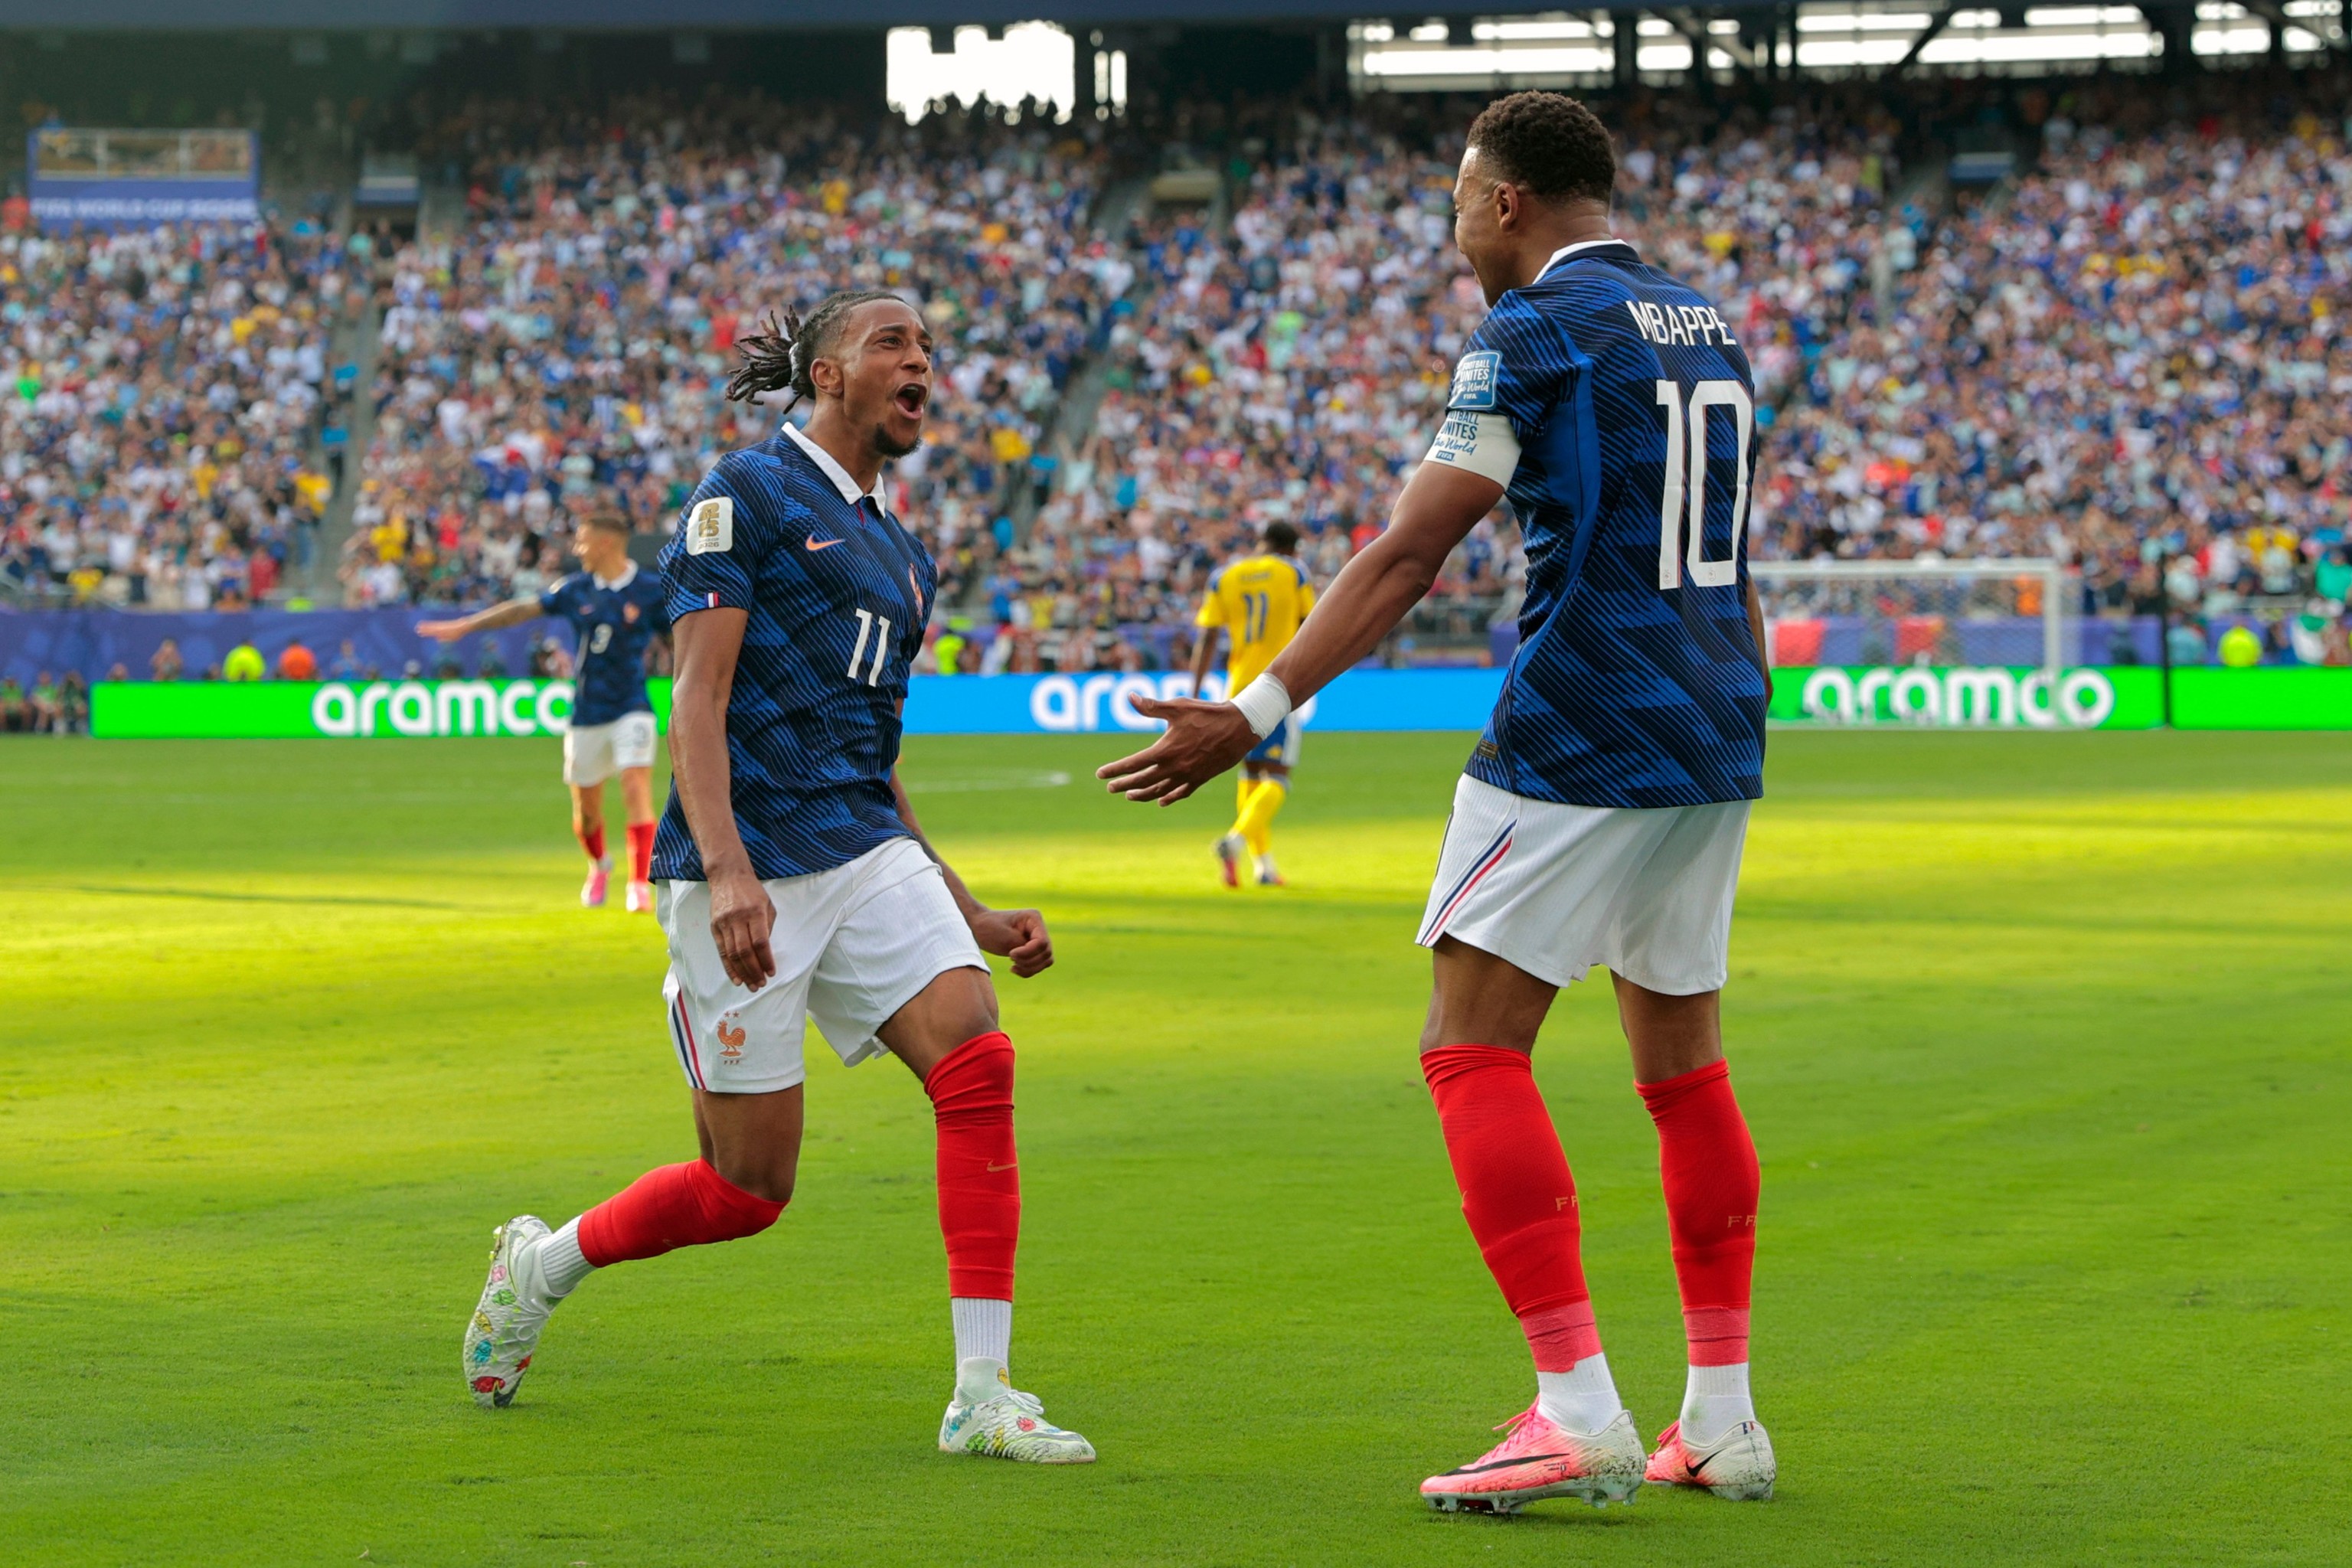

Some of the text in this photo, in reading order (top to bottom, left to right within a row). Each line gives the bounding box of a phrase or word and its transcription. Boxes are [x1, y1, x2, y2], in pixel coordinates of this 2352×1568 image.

[1625, 300, 1736, 346] MBAPPE
[1460, 368, 1490, 383] UNITES
[1466, 380, 1490, 393] World
[1437, 452, 1453, 460] FIFA
[1444, 437, 1478, 456] World
[1656, 379, 1753, 590] 10
[1243, 592, 1269, 644] 11
[847, 608, 890, 688] 11
[1802, 668, 2115, 729] aramco
